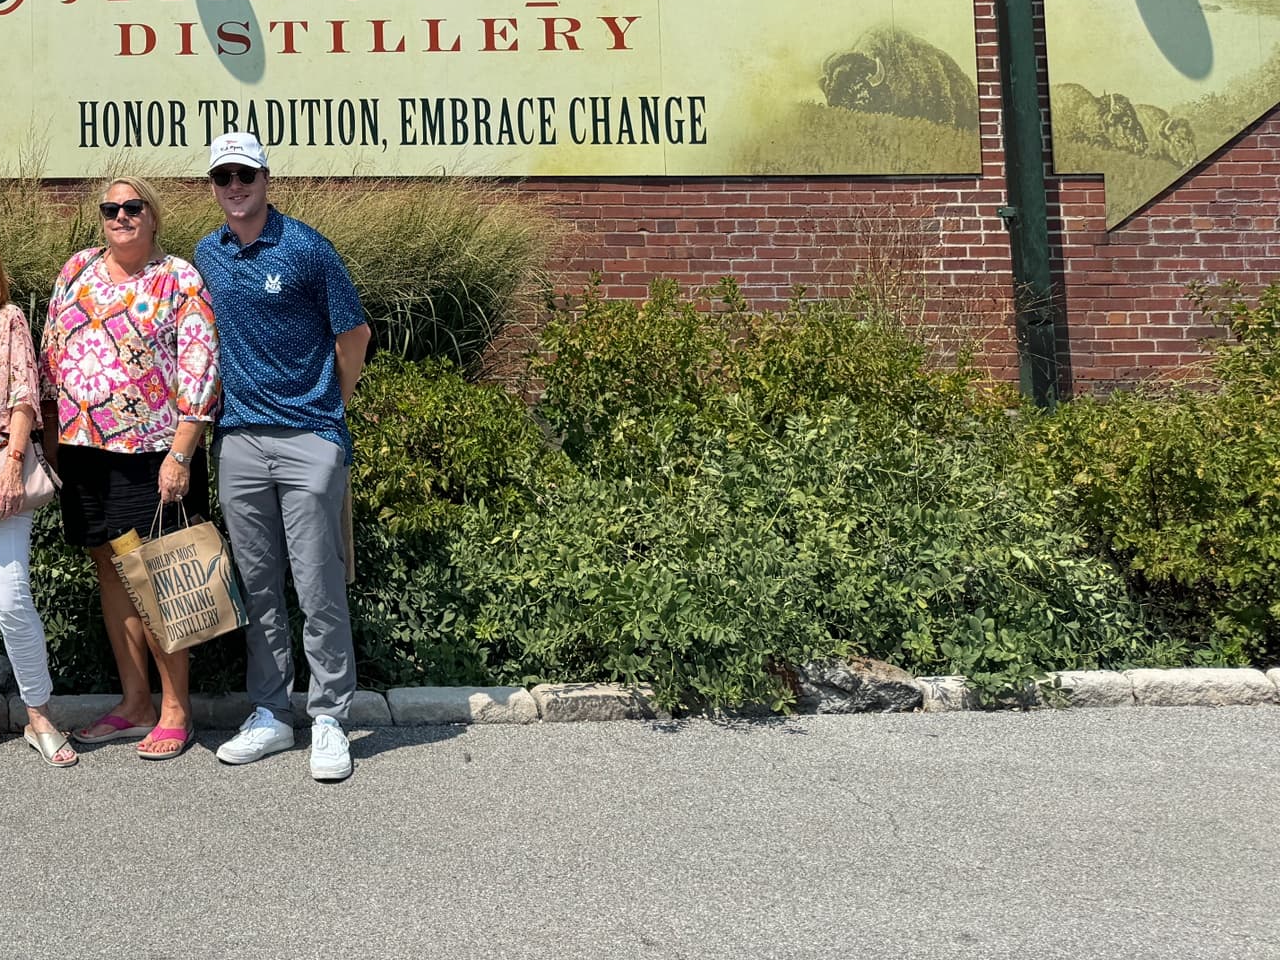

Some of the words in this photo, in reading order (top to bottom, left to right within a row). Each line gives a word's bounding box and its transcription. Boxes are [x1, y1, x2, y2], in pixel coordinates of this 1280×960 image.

[114, 15, 642, 56] DISTILLERY
[77, 100, 187, 148] HONOR
[198, 98, 389, 152] TRADITION,
[398, 96, 556, 146] EMBRACE
[568, 95, 708, 146] CHANGE
[144, 550, 177, 572] WORLD'S
[176, 543, 198, 563] MOST
[152, 559, 208, 601] AWARD
[160, 587, 216, 623] WINNING
[166, 608, 220, 642] DISTILLERY
